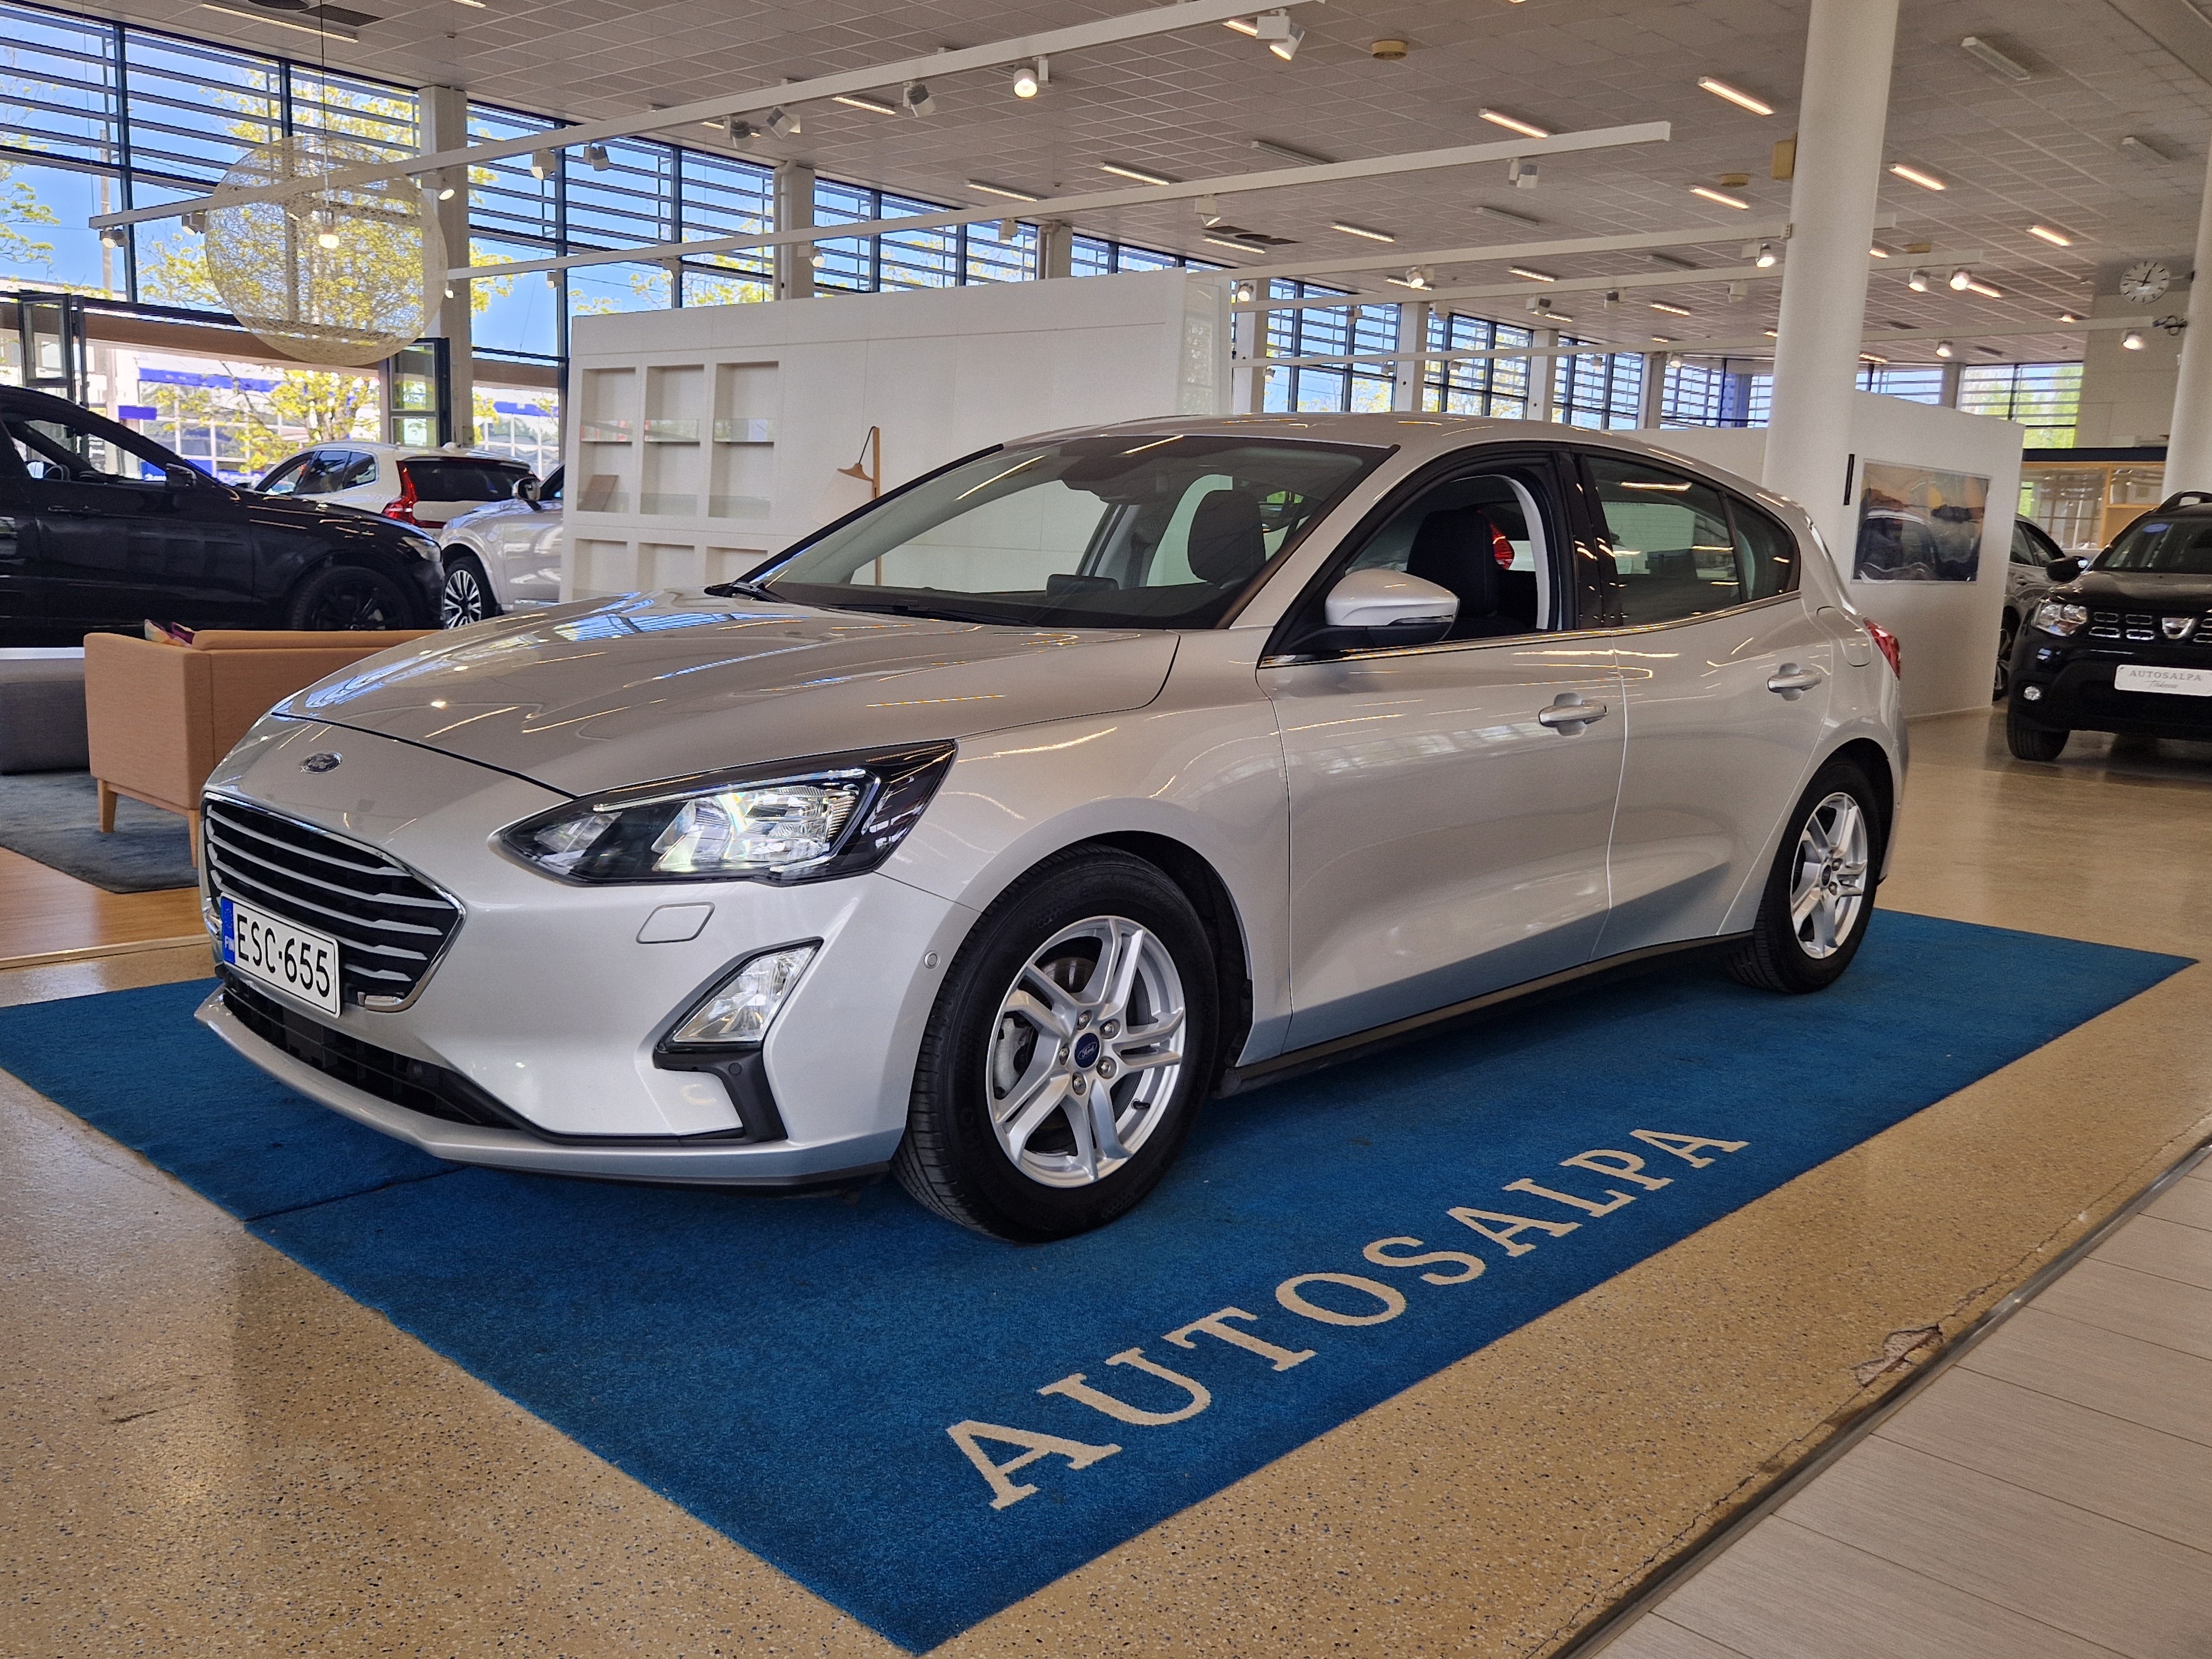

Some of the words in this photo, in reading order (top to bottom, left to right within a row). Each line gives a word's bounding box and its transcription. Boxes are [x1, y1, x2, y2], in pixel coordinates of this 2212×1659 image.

[2130, 670, 2201, 681] AUTOSALPA
[237, 914, 330, 998] ESC-655
[946, 1129, 1749, 1510] AUTOSALPA
